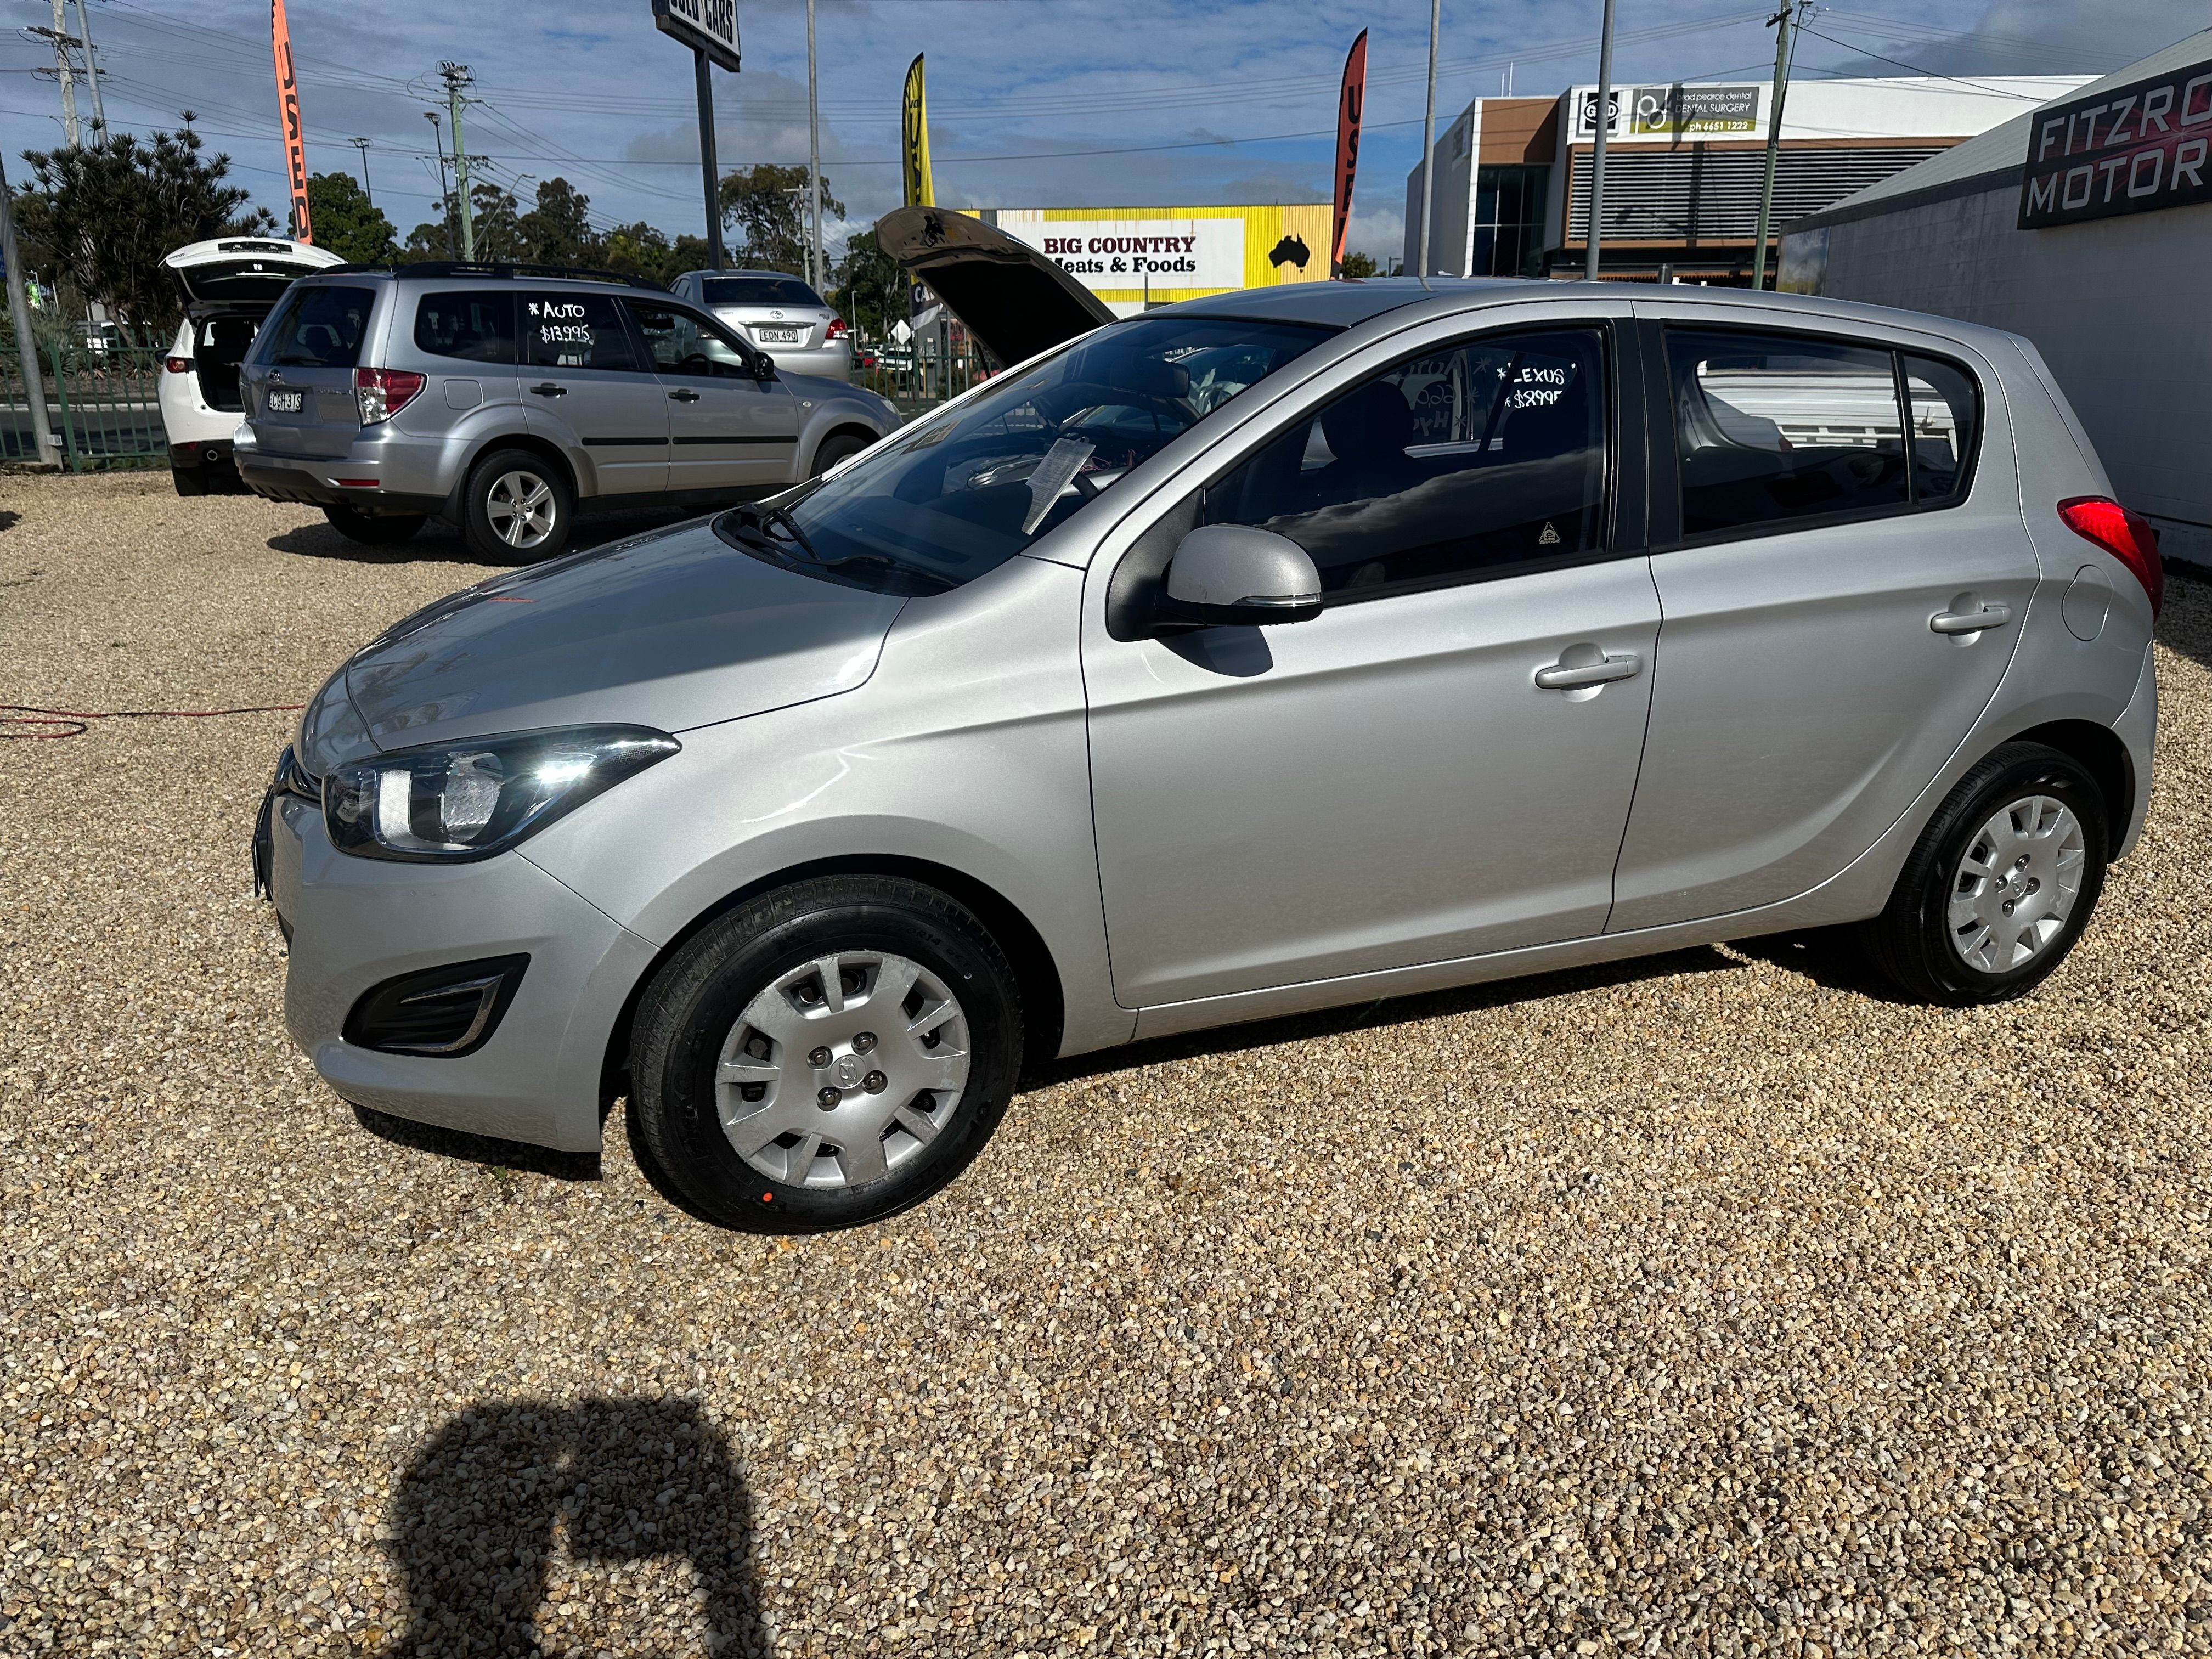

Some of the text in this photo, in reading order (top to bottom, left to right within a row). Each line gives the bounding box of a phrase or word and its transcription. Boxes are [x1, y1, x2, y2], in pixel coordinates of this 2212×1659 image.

[1696, 93, 1725, 102] pearce
[1726, 92, 1752, 101] dental
[1586, 105, 1615, 117] GD
[1675, 103, 1751, 113] DENTAL SURGERY
[2038, 72, 2212, 162] FITZRO
[1689, 121, 1748, 132] ph 6651 1222
[279, 41, 309, 238] USED
[2026, 138, 2208, 217] MOTOR
[1043, 236, 1196, 254] BIG COUNTRY
[1110, 257, 1127, 273] &
[1132, 256, 1196, 273] Foods
[544, 301, 585, 318] AUTO
